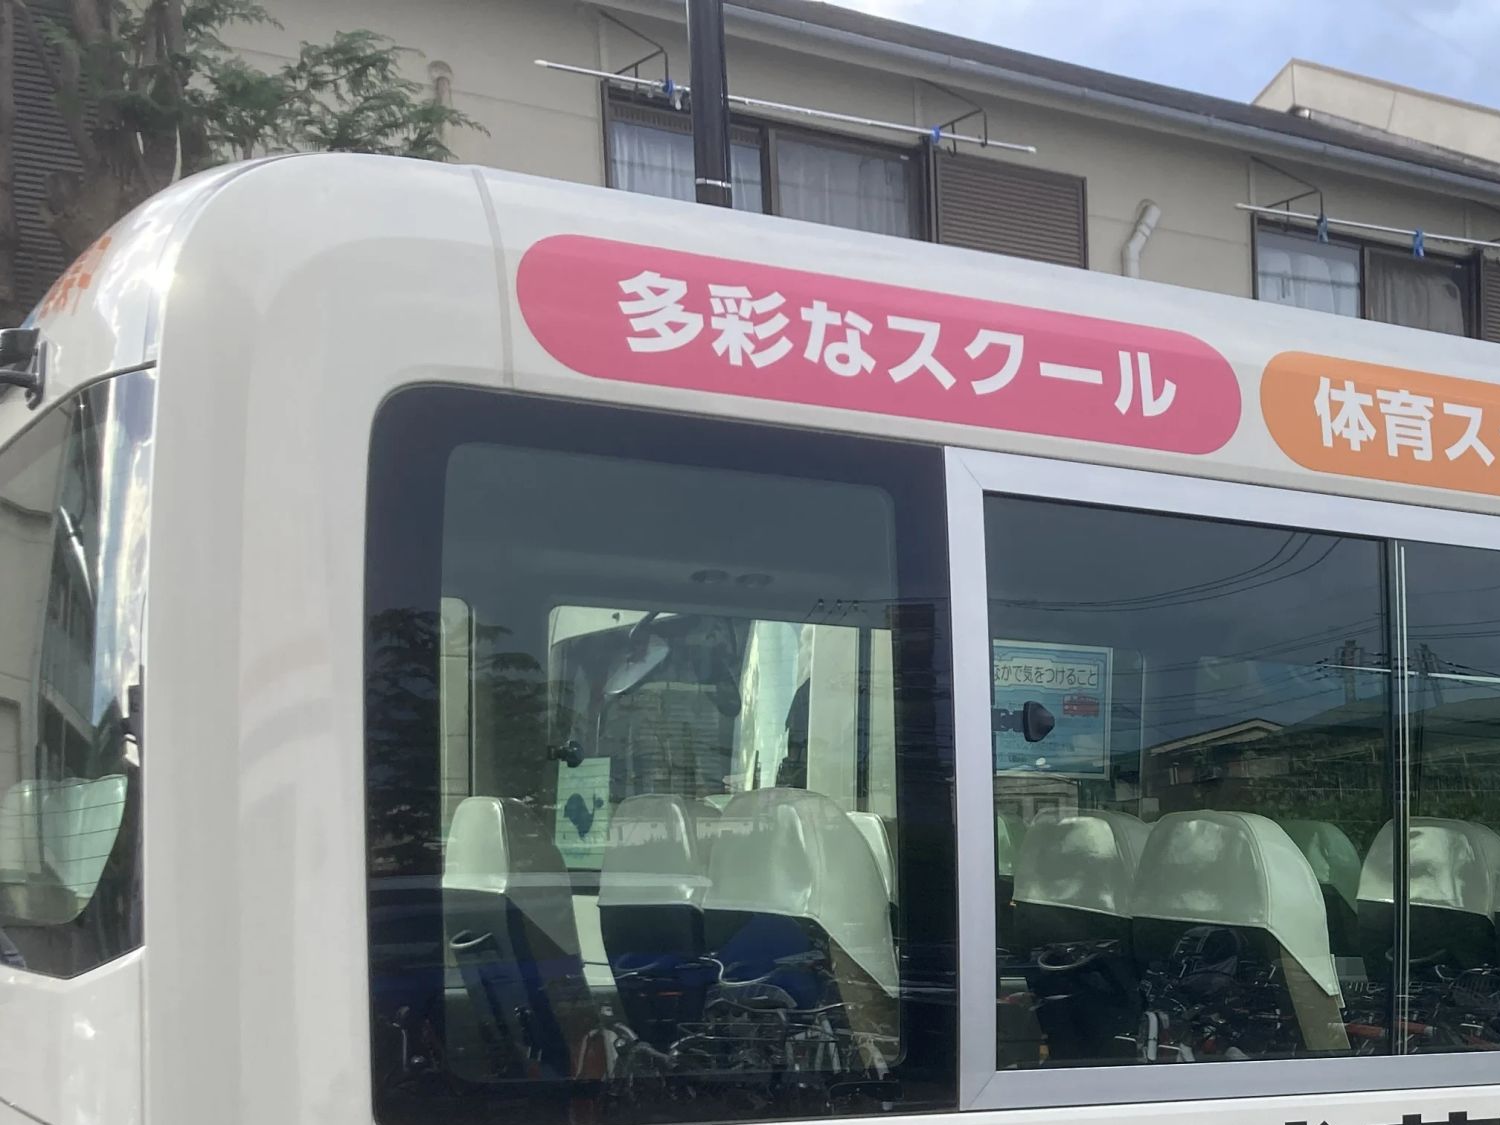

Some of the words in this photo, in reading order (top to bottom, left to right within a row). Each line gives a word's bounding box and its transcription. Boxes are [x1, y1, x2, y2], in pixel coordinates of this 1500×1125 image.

[617, 270, 1177, 417] 多彩なスクール
